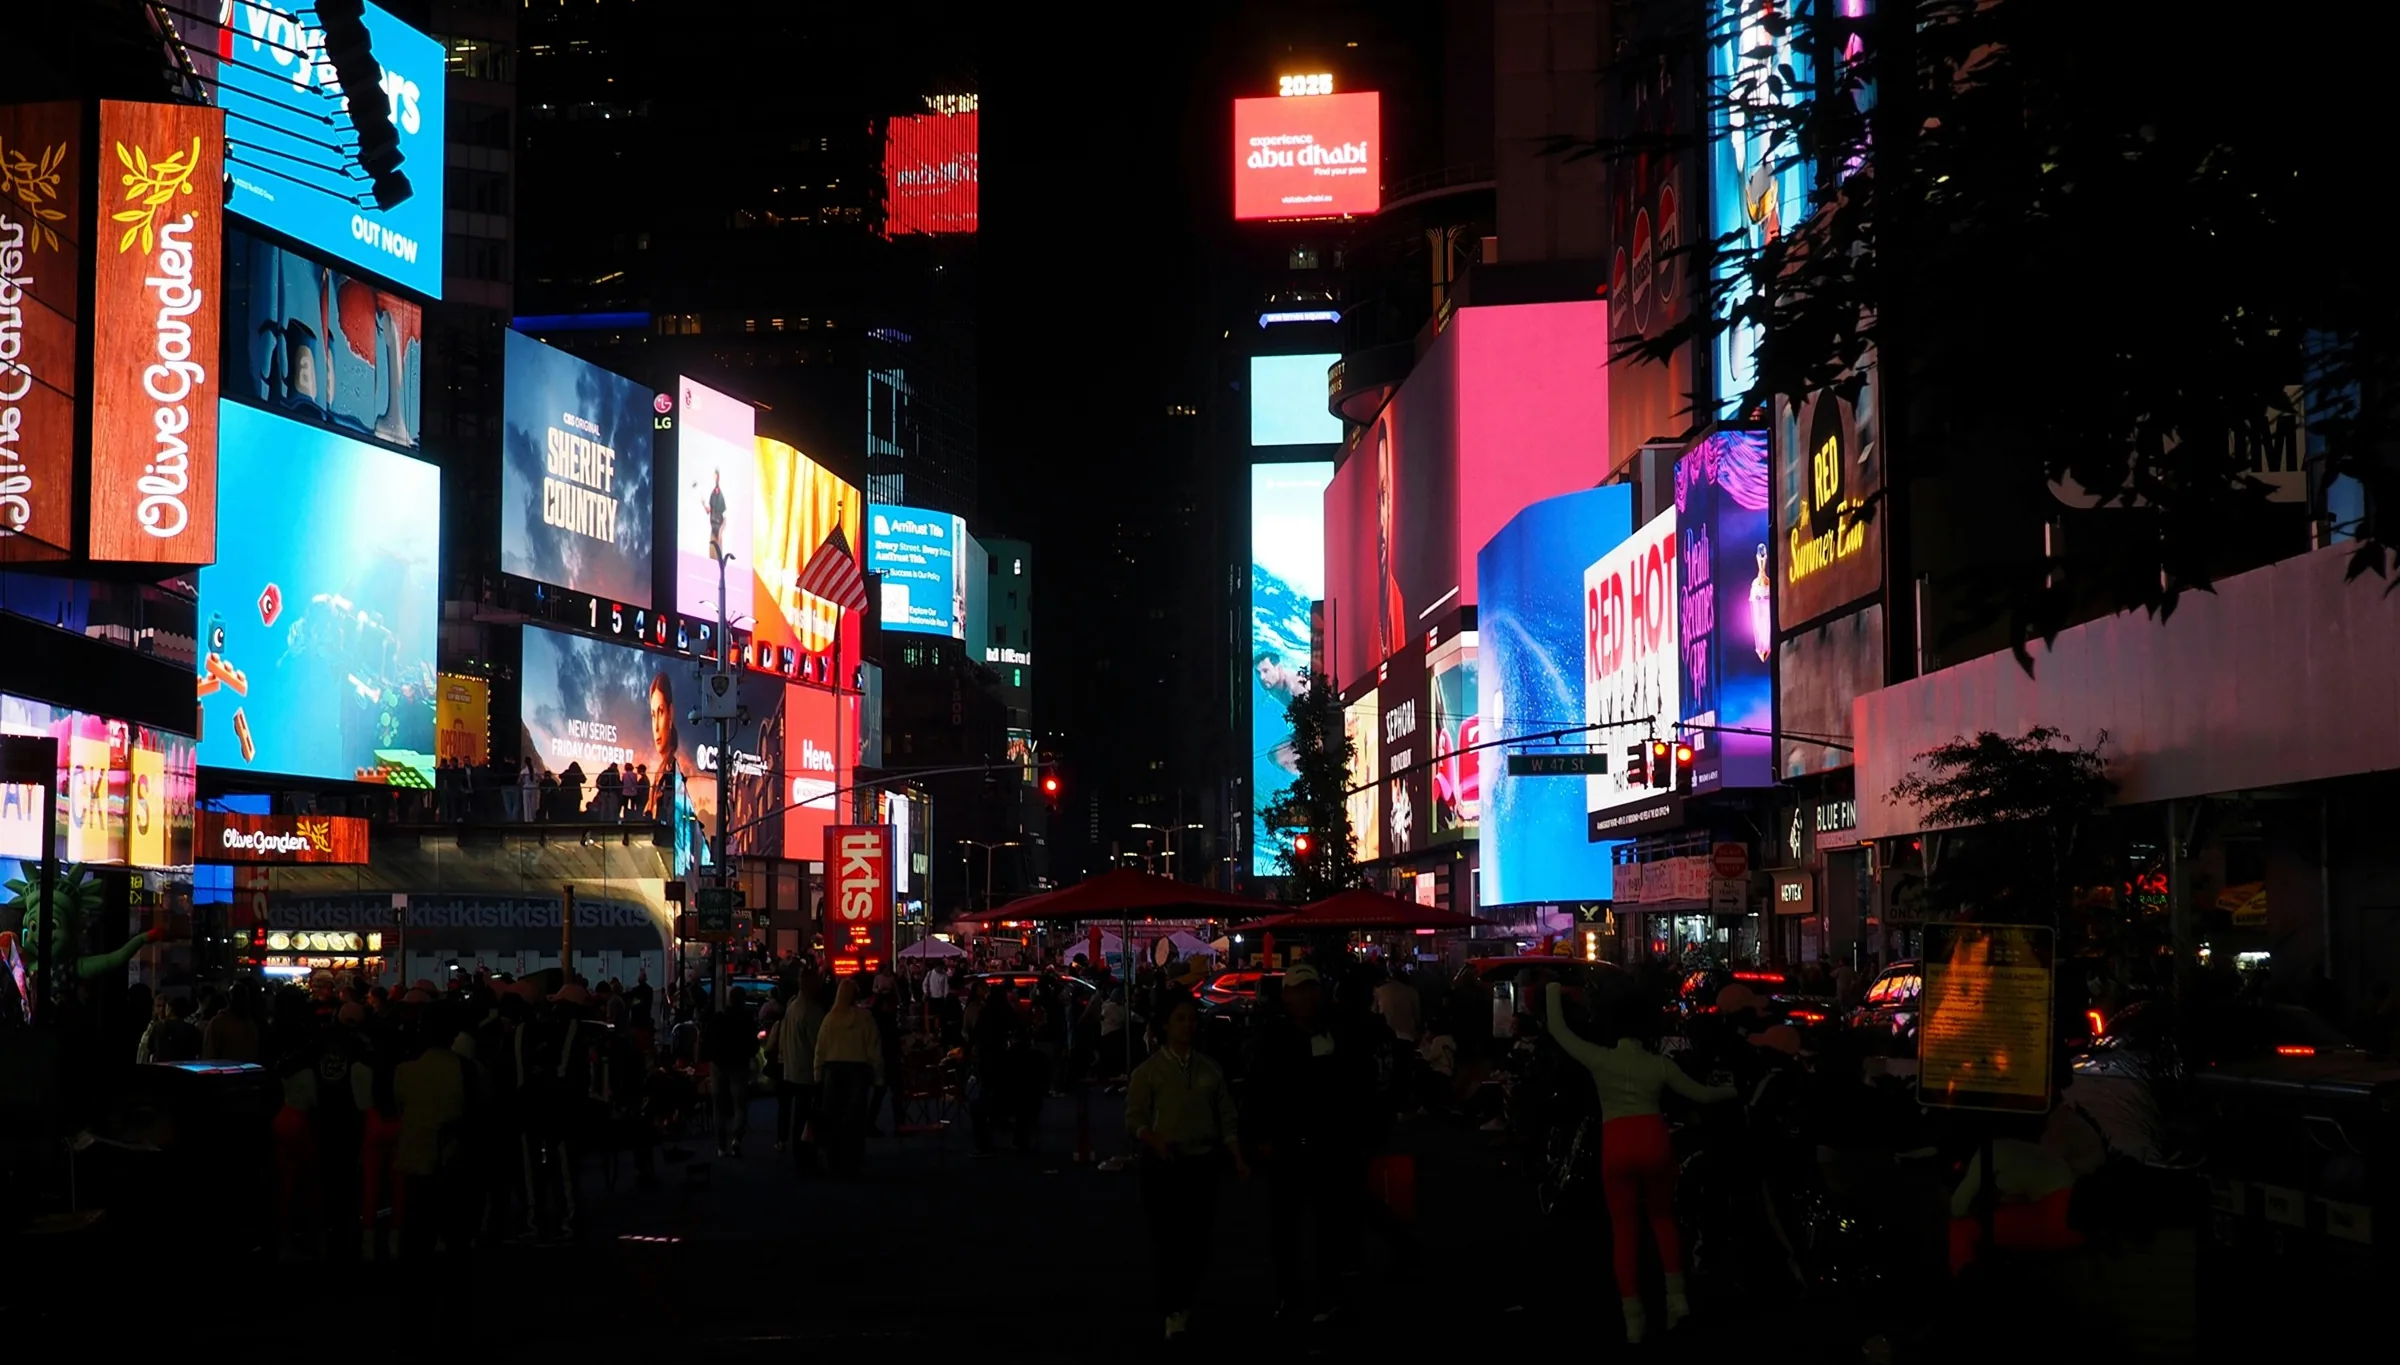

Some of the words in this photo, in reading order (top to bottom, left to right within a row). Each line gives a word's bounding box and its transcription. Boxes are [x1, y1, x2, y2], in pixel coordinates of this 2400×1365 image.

[1279, 73, 1333, 97] 2025
[1247, 147, 1294, 168] abu
[351, 214, 381, 248] OUT
[381, 227, 418, 264] NOW
[143, 213, 204, 402] Garden
[575, 416, 600, 436] ORIGINAL
[654, 417, 671, 429] LG
[137, 404, 189, 537] Olive
[547, 427, 615, 492] SHERIFF
[1815, 435, 1838, 512] RED
[544, 477, 617, 543] COUNTRY
[891, 520, 928, 536] AmTrust
[930, 523, 944, 538] Title
[1789, 528, 1835, 583] Summer
[588, 598, 667, 645] 1540
[1589, 571, 1625, 684] RED
[1630, 532, 1676, 663] HOT
[568, 719, 588, 738] NEW
[589, 721, 617, 743] SERIES
[1386, 698, 1416, 745] SEPHORA
[552, 738, 583, 759] FRIDAY
[583, 743, 624, 765] OCTOBER
[803, 739, 835, 772] Hero.
[1532, 757, 1544, 771] W
[1550, 757, 1566, 772] 47
[1571, 756, 1584, 771] St
[1816, 804, 1838, 831] BLUE
[1841, 800, 1856, 828] FIN
[223, 828, 253, 848] Olive
[253, 831, 308, 854] Garden
[842, 831, 882, 920] tkts
[1781, 884, 1803, 902] HEYTEA
[1890, 909, 1921, 920] ONLY
